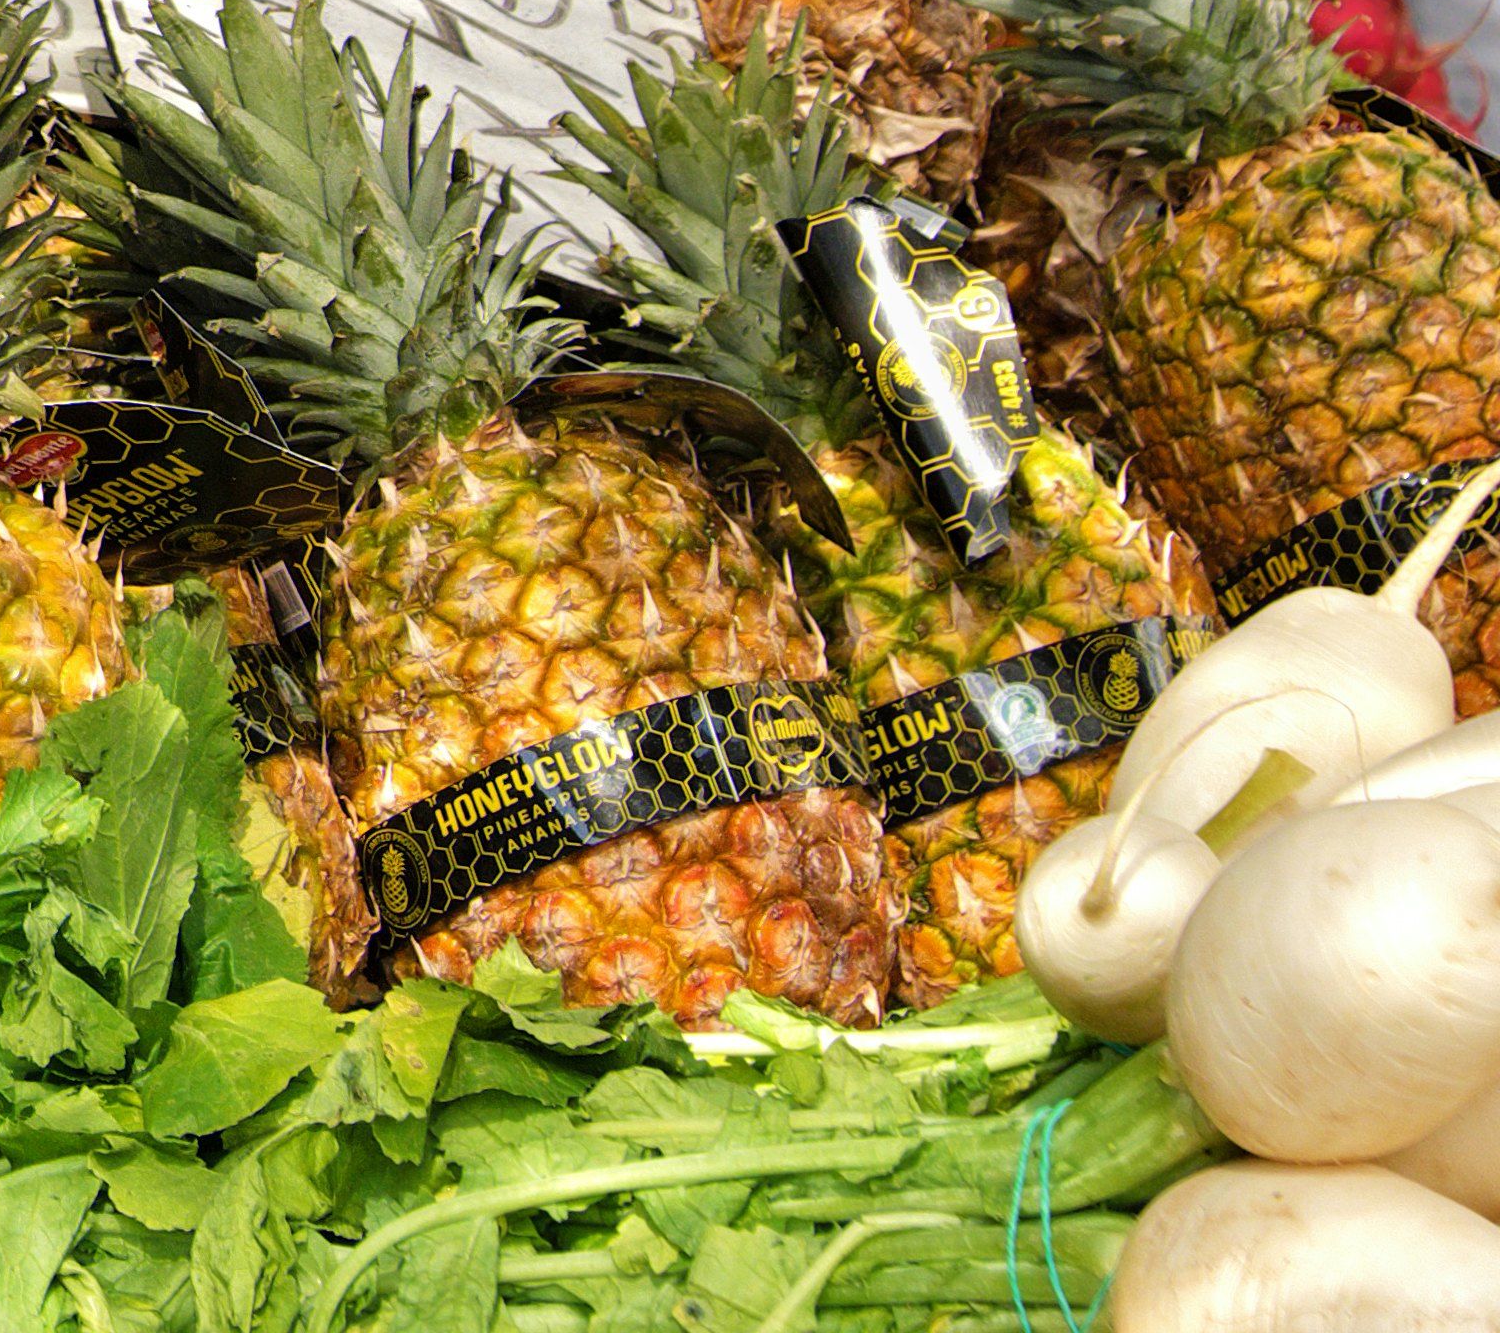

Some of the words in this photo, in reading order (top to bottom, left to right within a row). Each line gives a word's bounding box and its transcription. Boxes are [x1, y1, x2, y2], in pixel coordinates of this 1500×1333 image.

[435, 729, 636, 837] HONEYGLOW
[482, 779, 604, 843] PINEAPPLE
[506, 806, 593, 856] ANANAS
